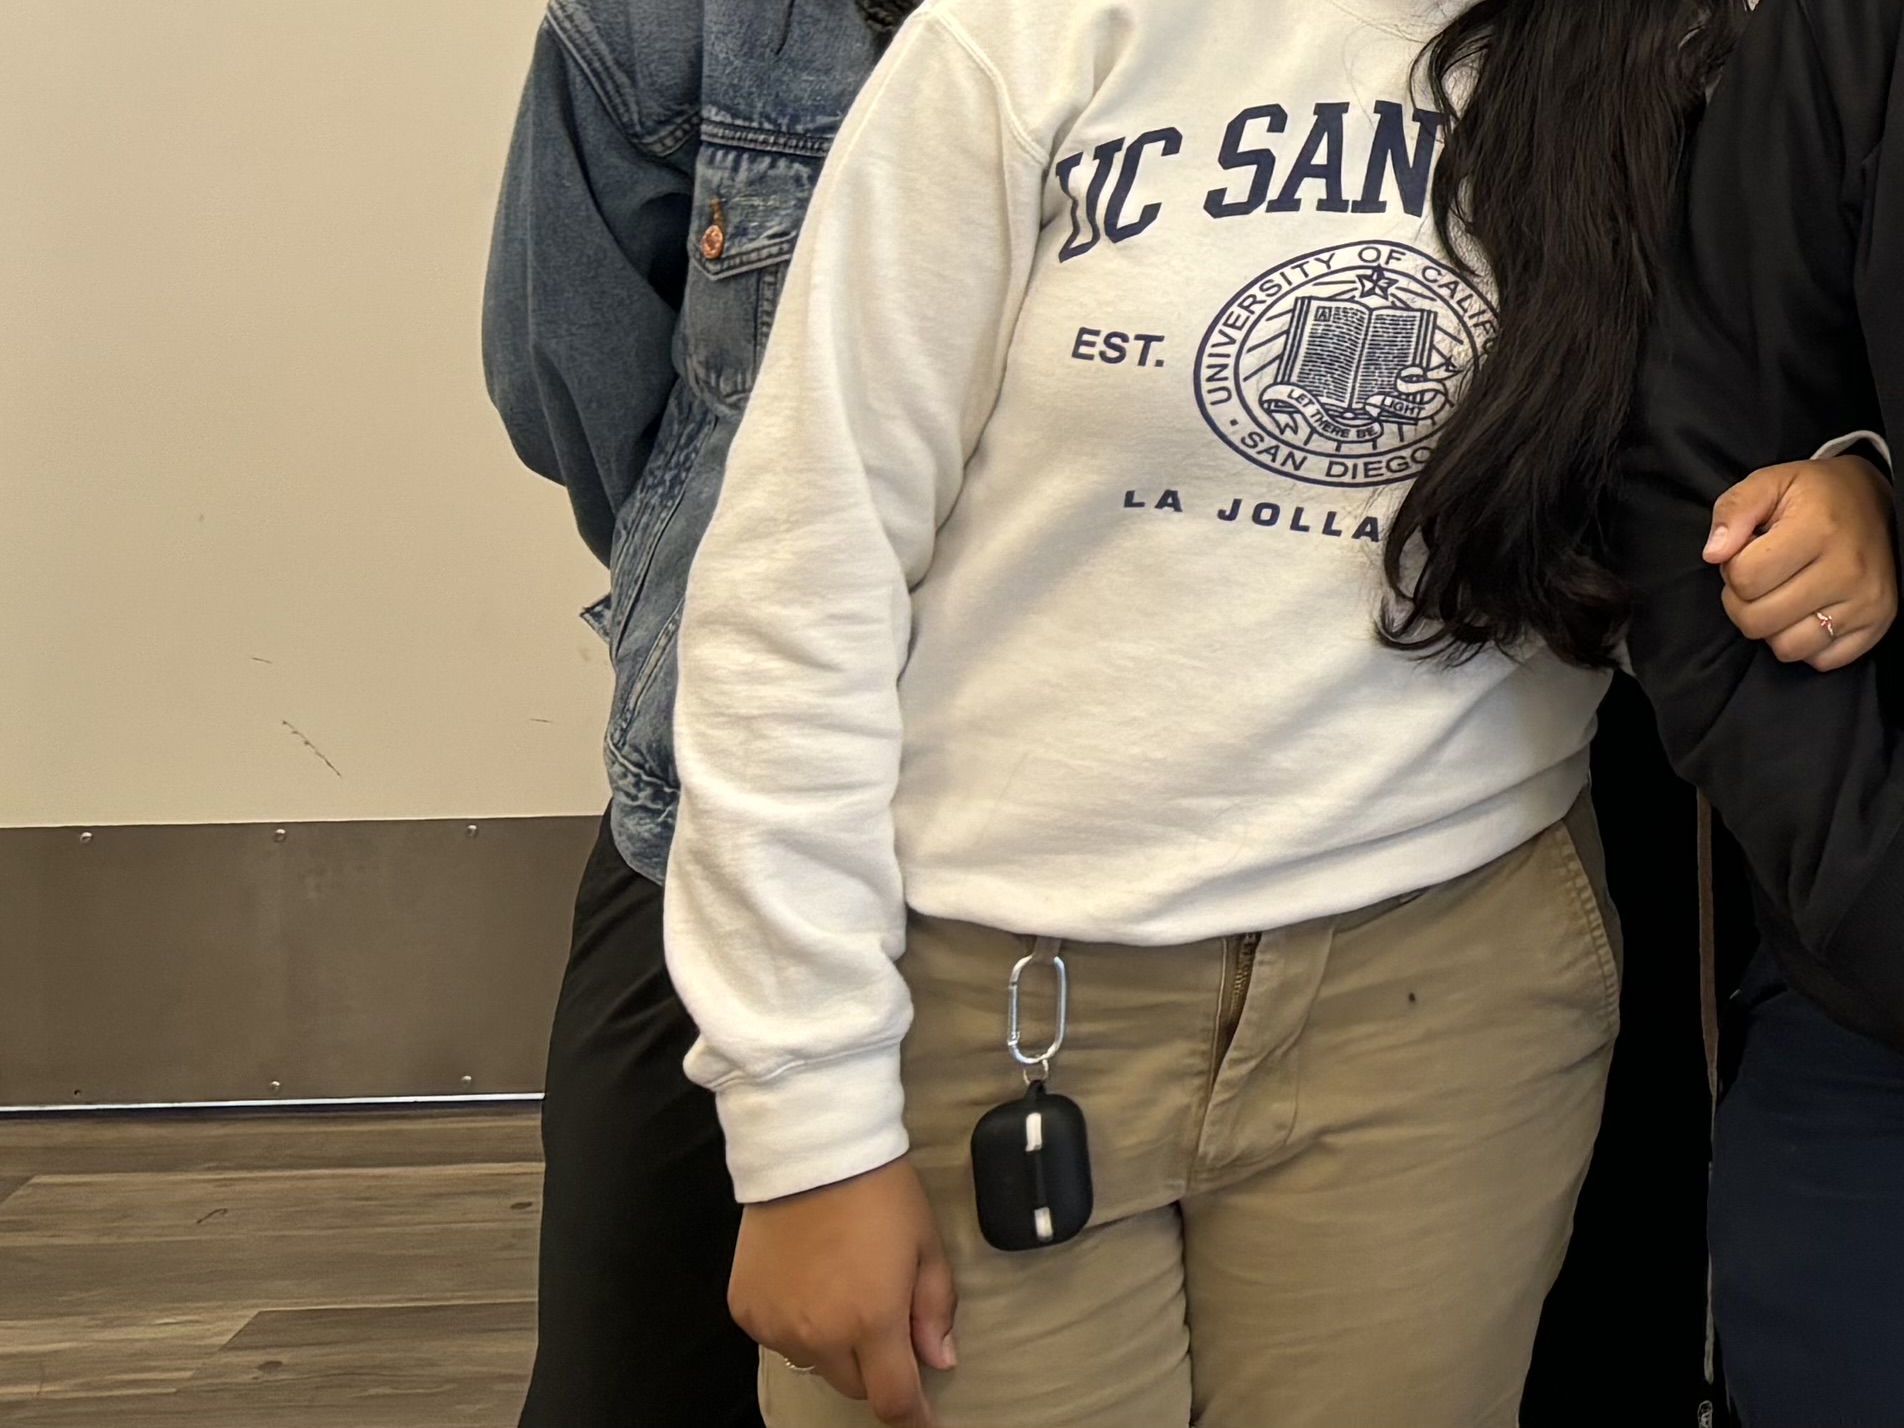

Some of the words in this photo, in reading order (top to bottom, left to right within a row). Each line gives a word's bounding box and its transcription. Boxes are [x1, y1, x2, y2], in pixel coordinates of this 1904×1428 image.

[1055, 126, 1183, 264] UC
[1203, 100, 1448, 218] SAN
[1071, 327, 1165, 368] EST.
[1206, 252, 1336, 406] UNIVERSITY
[1358, 246, 1406, 265] OF
[1287, 389, 1315, 408] LET
[1310, 409, 1350, 439] THERE
[1355, 426, 1378, 439] BE
[1383, 396, 1426, 416] LIGHT
[1240, 431, 1308, 472] SAN
[1325, 446, 1433, 479] DIEGO
[1123, 489, 1183, 512] LA
[1217, 497, 1381, 542] JOLLA
